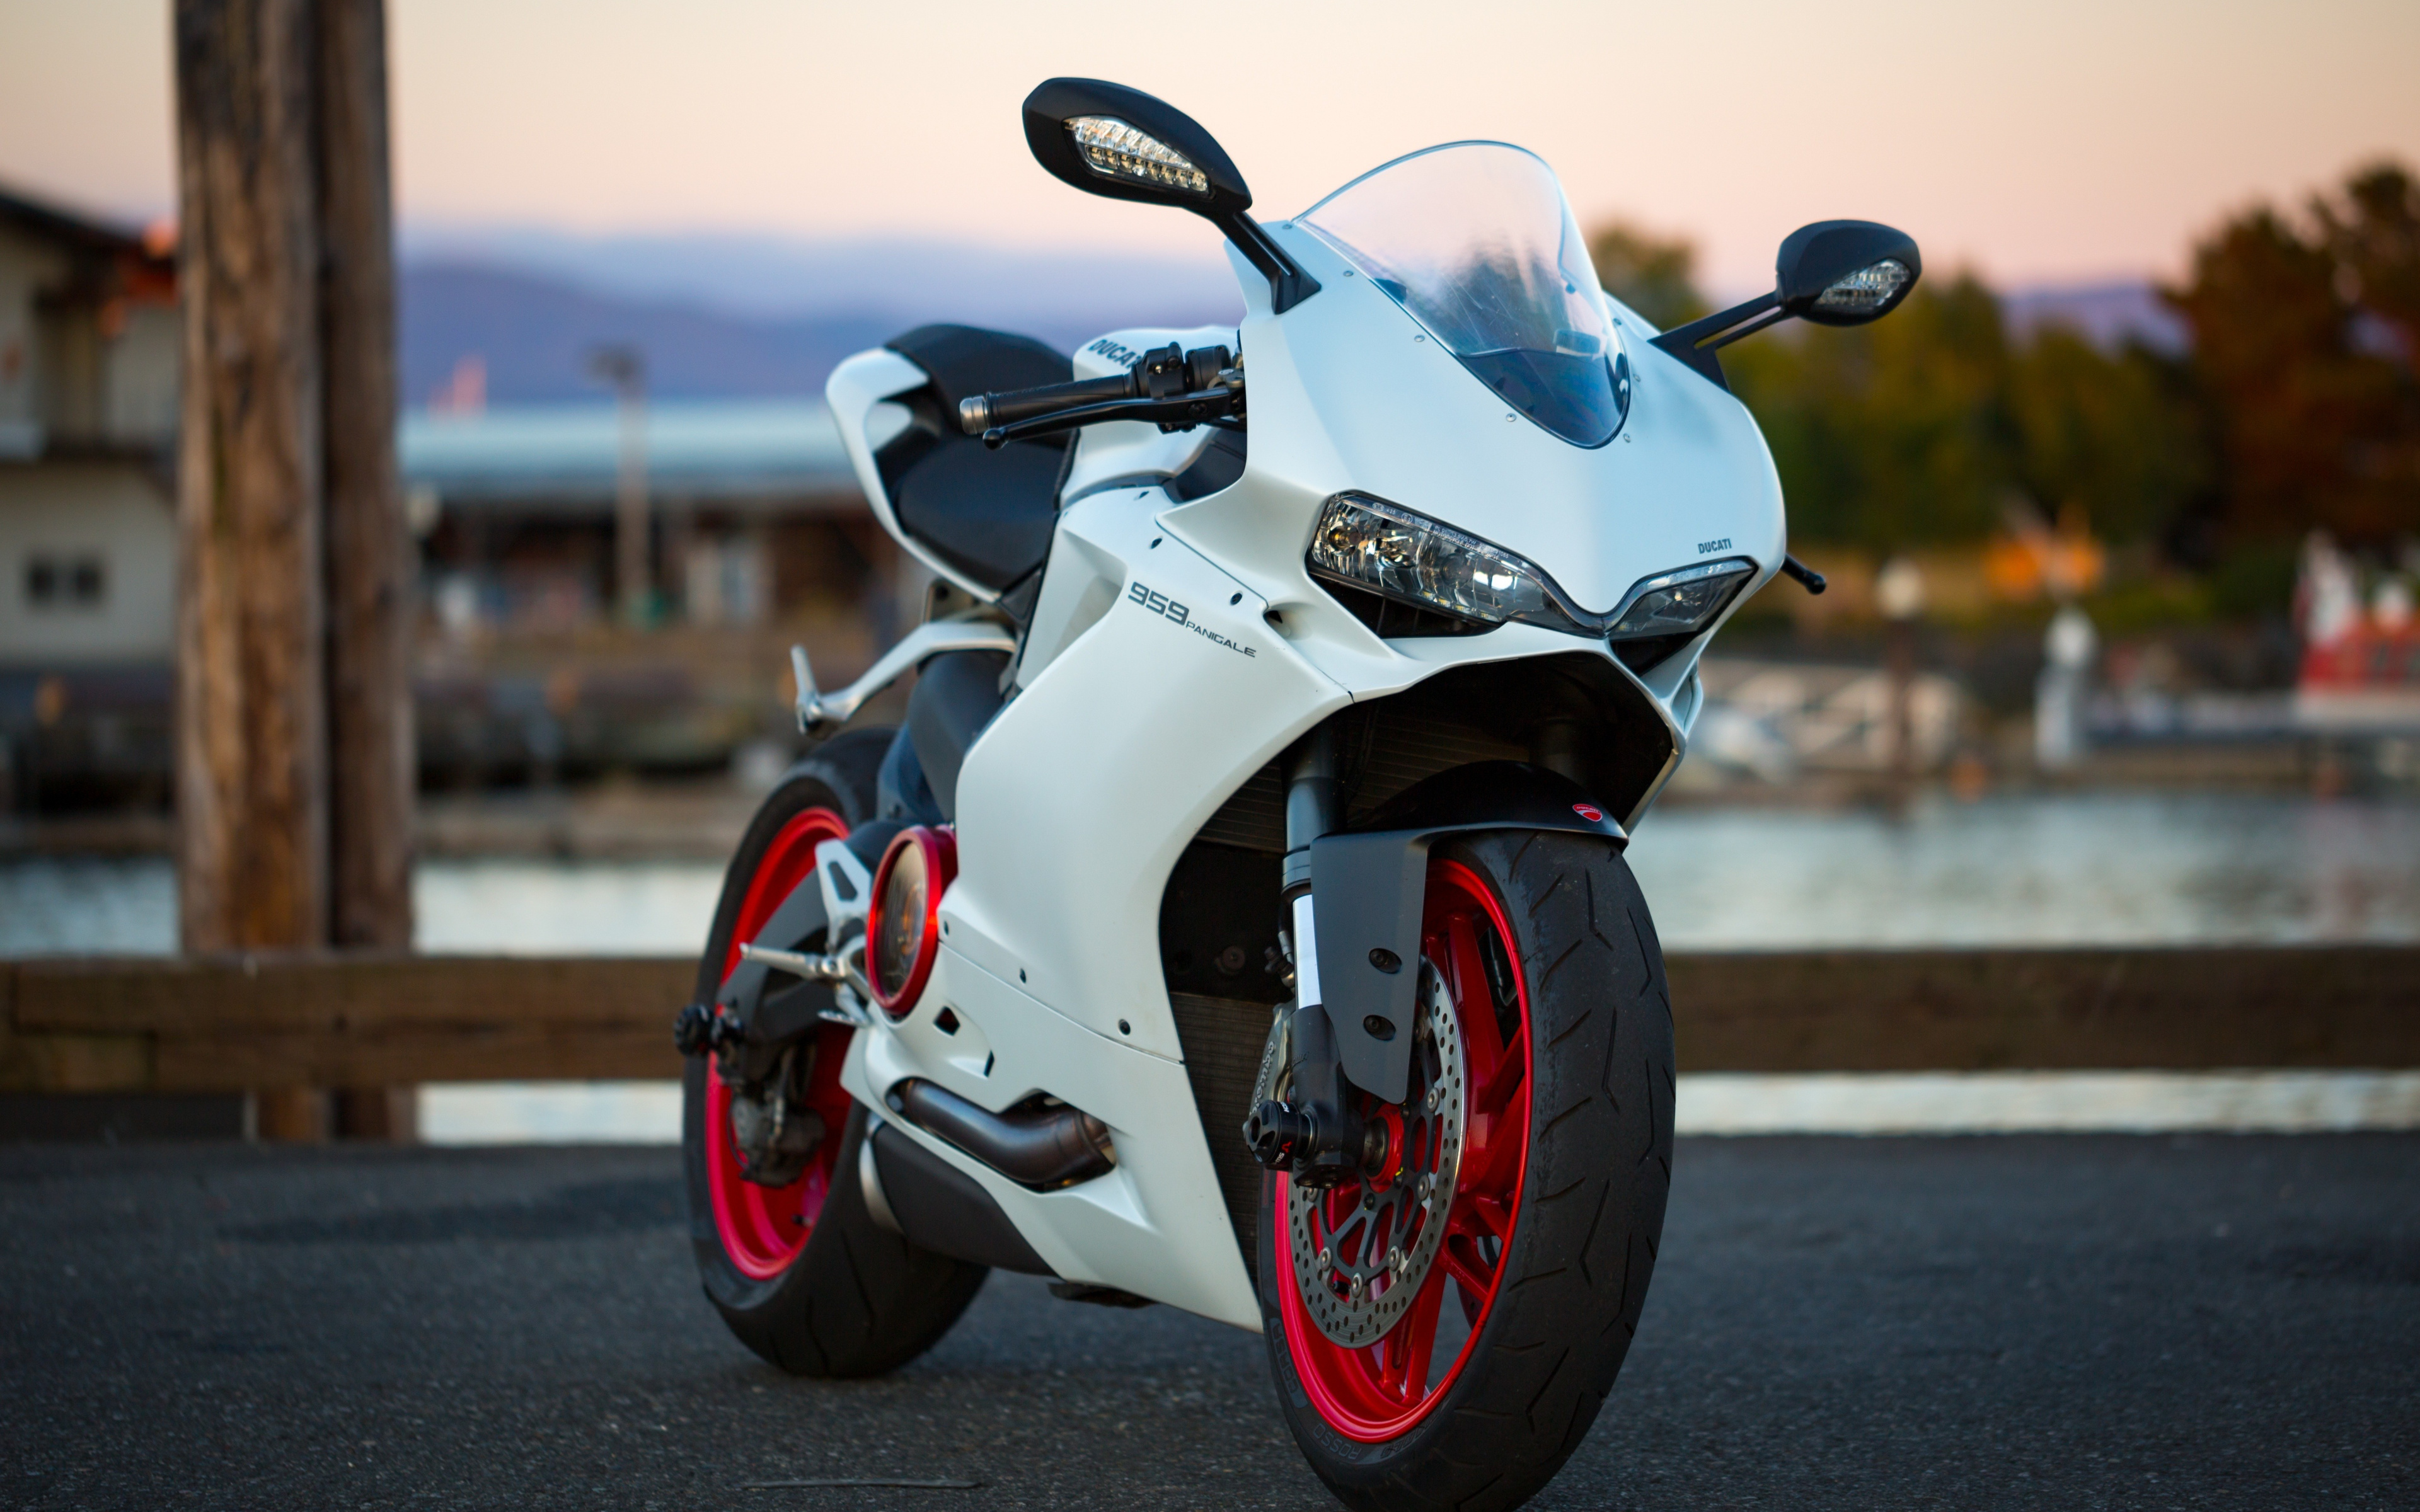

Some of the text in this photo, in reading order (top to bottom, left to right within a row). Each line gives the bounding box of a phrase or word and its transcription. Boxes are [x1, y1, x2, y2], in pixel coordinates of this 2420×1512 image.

[1088, 338, 1143, 369] DUCA
[1697, 538, 1732, 554] DUCATI
[1127, 581, 1257, 658] 959 PANIGALE
[1272, 1322, 1299, 1394] CORSA
[1313, 1423, 1363, 1460] ROSSO
